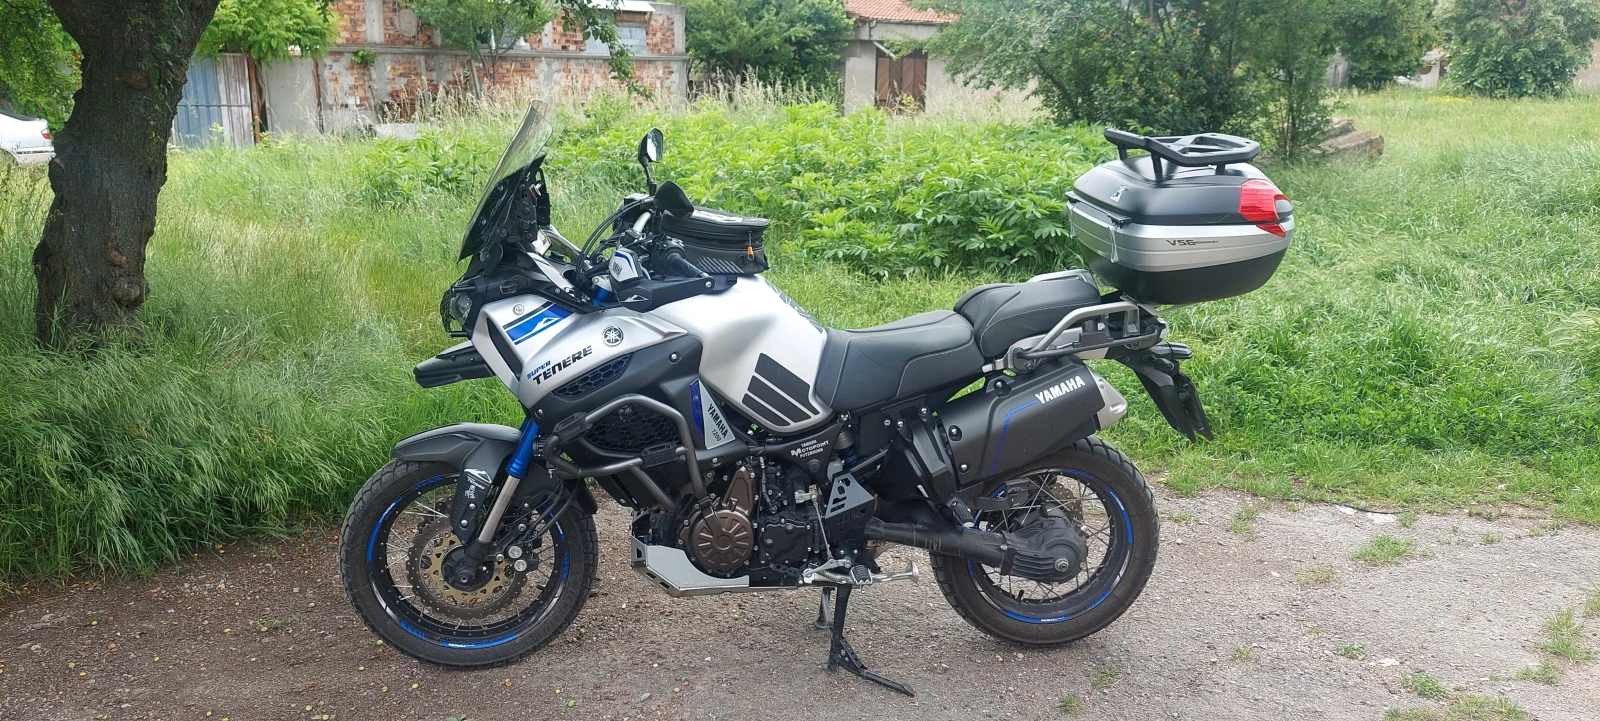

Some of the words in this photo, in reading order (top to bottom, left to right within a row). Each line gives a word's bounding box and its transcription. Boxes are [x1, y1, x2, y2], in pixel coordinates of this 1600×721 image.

[526, 360, 551, 380] SUPER
[1035, 375, 1086, 404] YAMAHA
[707, 403, 728, 439] YAMAHA
[711, 429, 722, 442] 1200
[790, 440, 829, 457] MOTOPOINT
